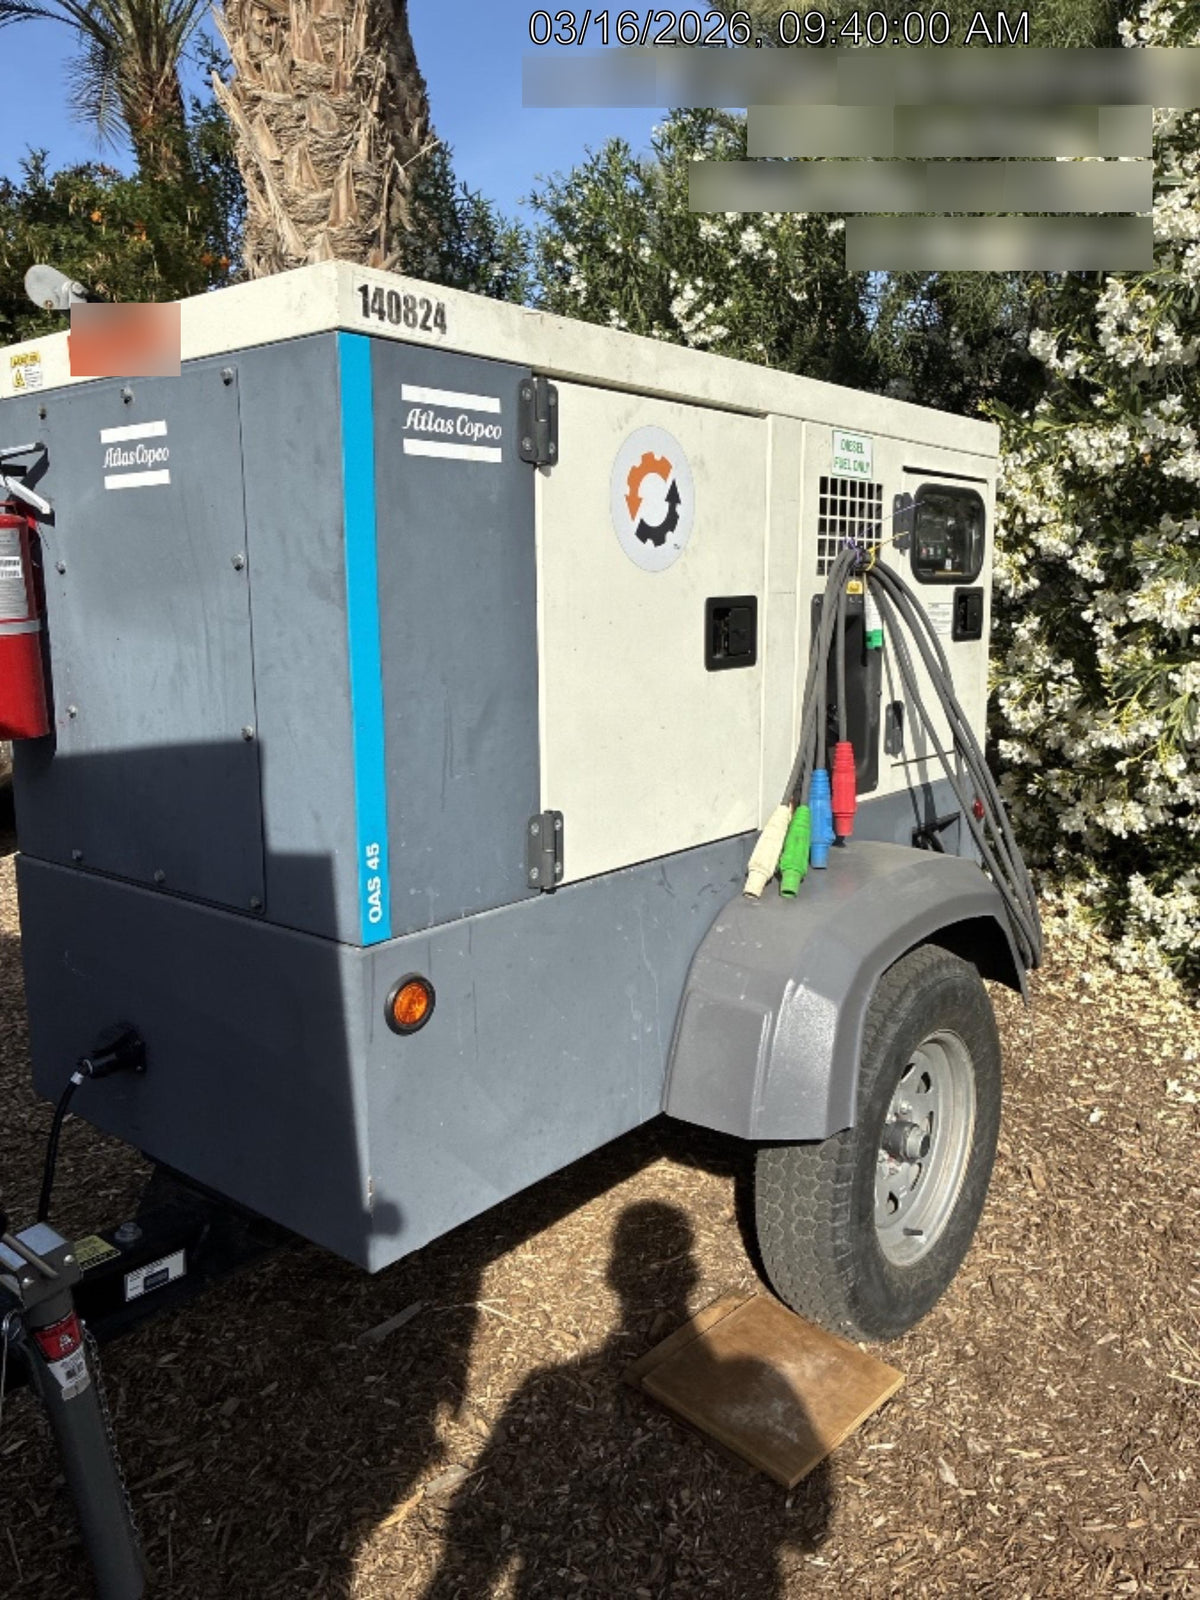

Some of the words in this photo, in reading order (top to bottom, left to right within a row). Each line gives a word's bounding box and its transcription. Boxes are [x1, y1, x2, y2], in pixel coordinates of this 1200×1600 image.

[358, 284, 447, 335] 140824
[402, 408, 454, 434] Atlas
[456, 414, 502, 441] Copco
[103, 446, 135, 468] Atlas
[136, 443, 169, 467] Copco
[365, 842, 380, 870] 45
